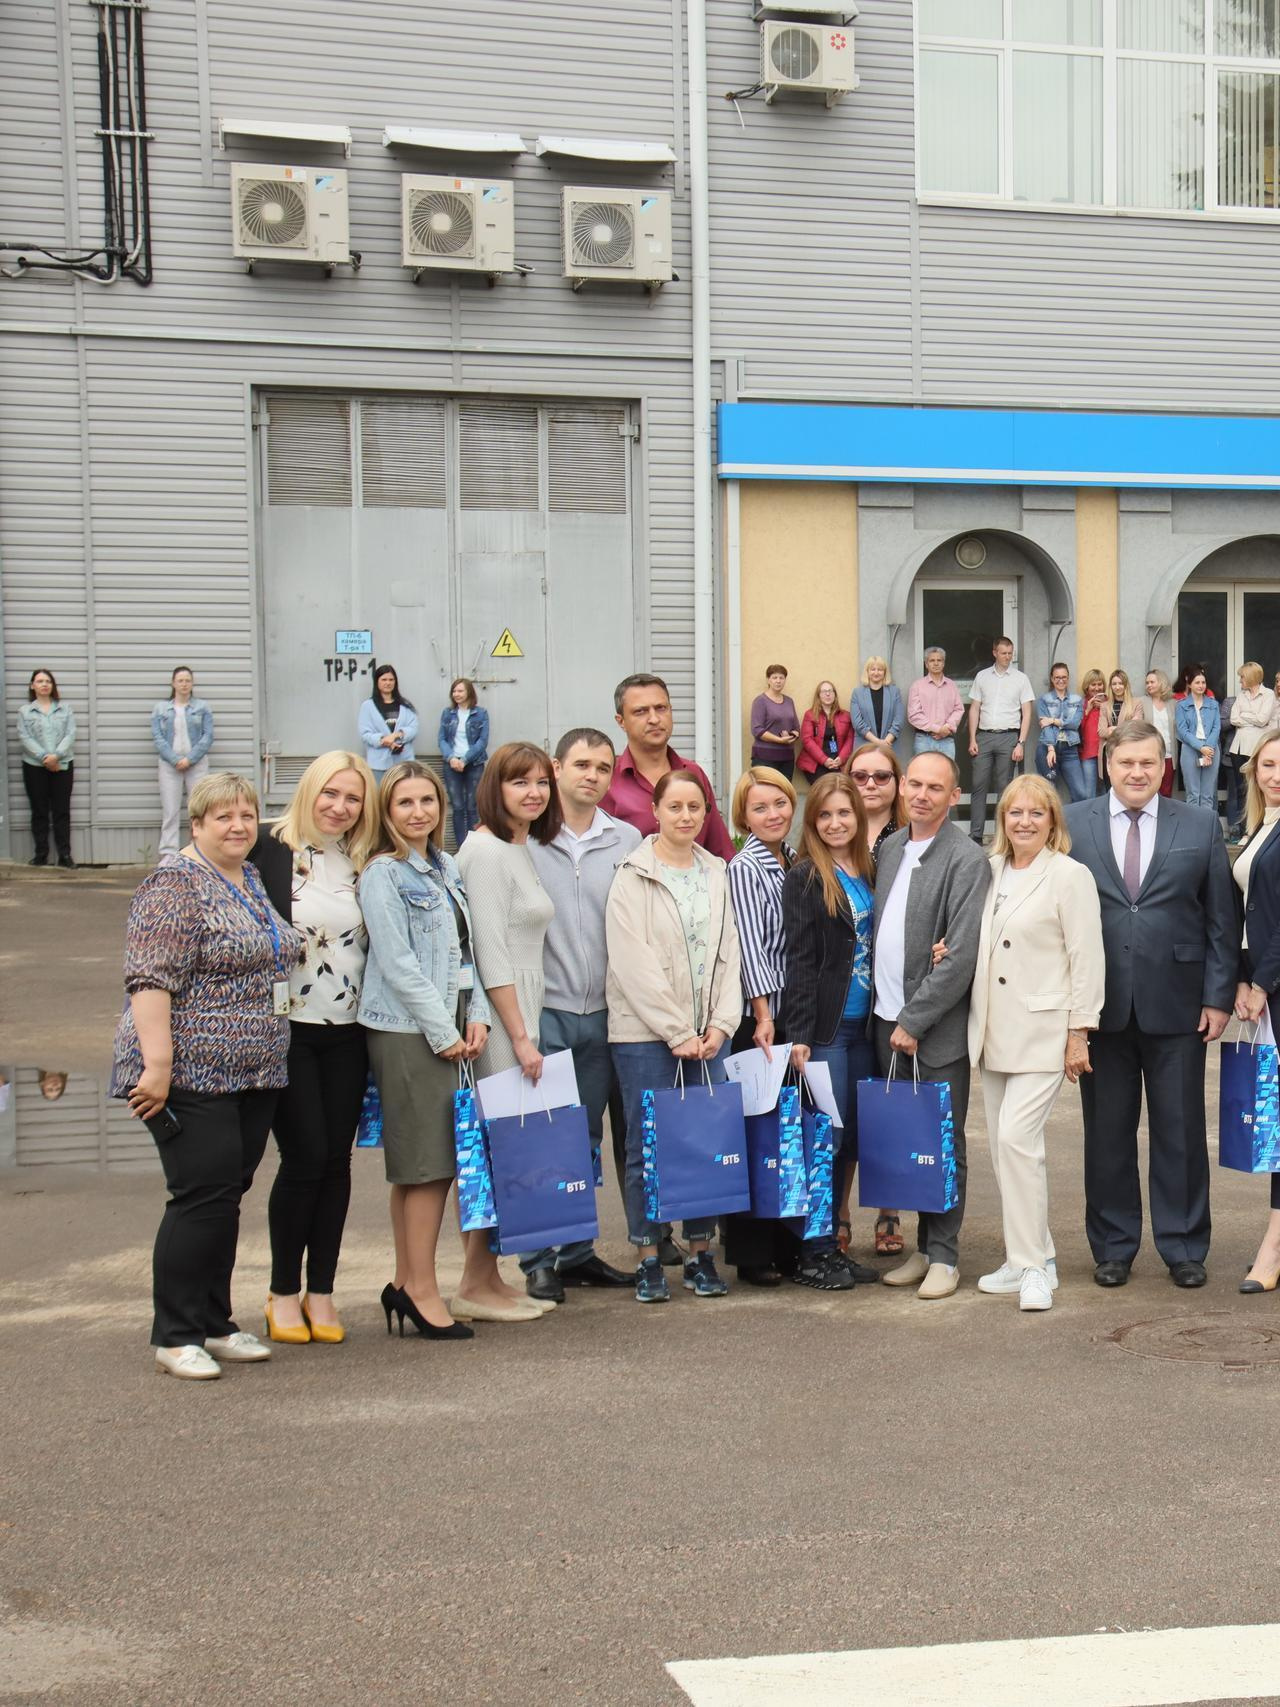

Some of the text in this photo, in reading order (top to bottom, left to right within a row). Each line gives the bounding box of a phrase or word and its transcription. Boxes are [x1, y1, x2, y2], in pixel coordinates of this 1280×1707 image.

[722, 1153, 740, 1165] ВТБ
[917, 1154, 935, 1165] ВТБ
[567, 1180, 586, 1192] ВТБ
